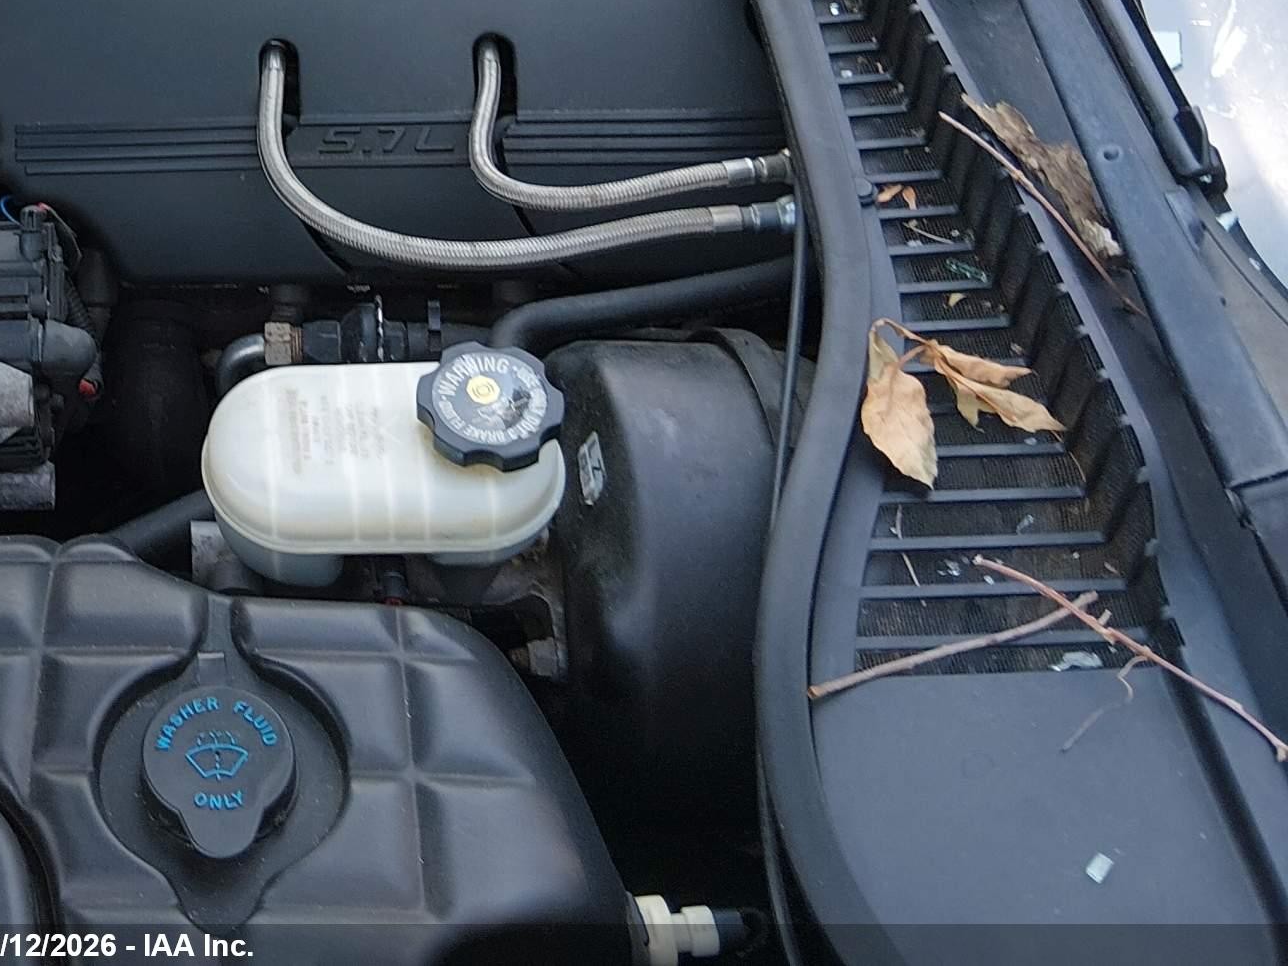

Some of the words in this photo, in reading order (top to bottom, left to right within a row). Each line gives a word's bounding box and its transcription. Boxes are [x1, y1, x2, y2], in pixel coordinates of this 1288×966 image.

[318, 126, 454, 154] 5.7L
[437, 354, 510, 397] WARNING
[462, 424, 507, 444] BRAKE
[155, 697, 220, 751] WASHER
[233, 700, 279, 746] FLUID
[194, 789, 245, 810] ONLY
